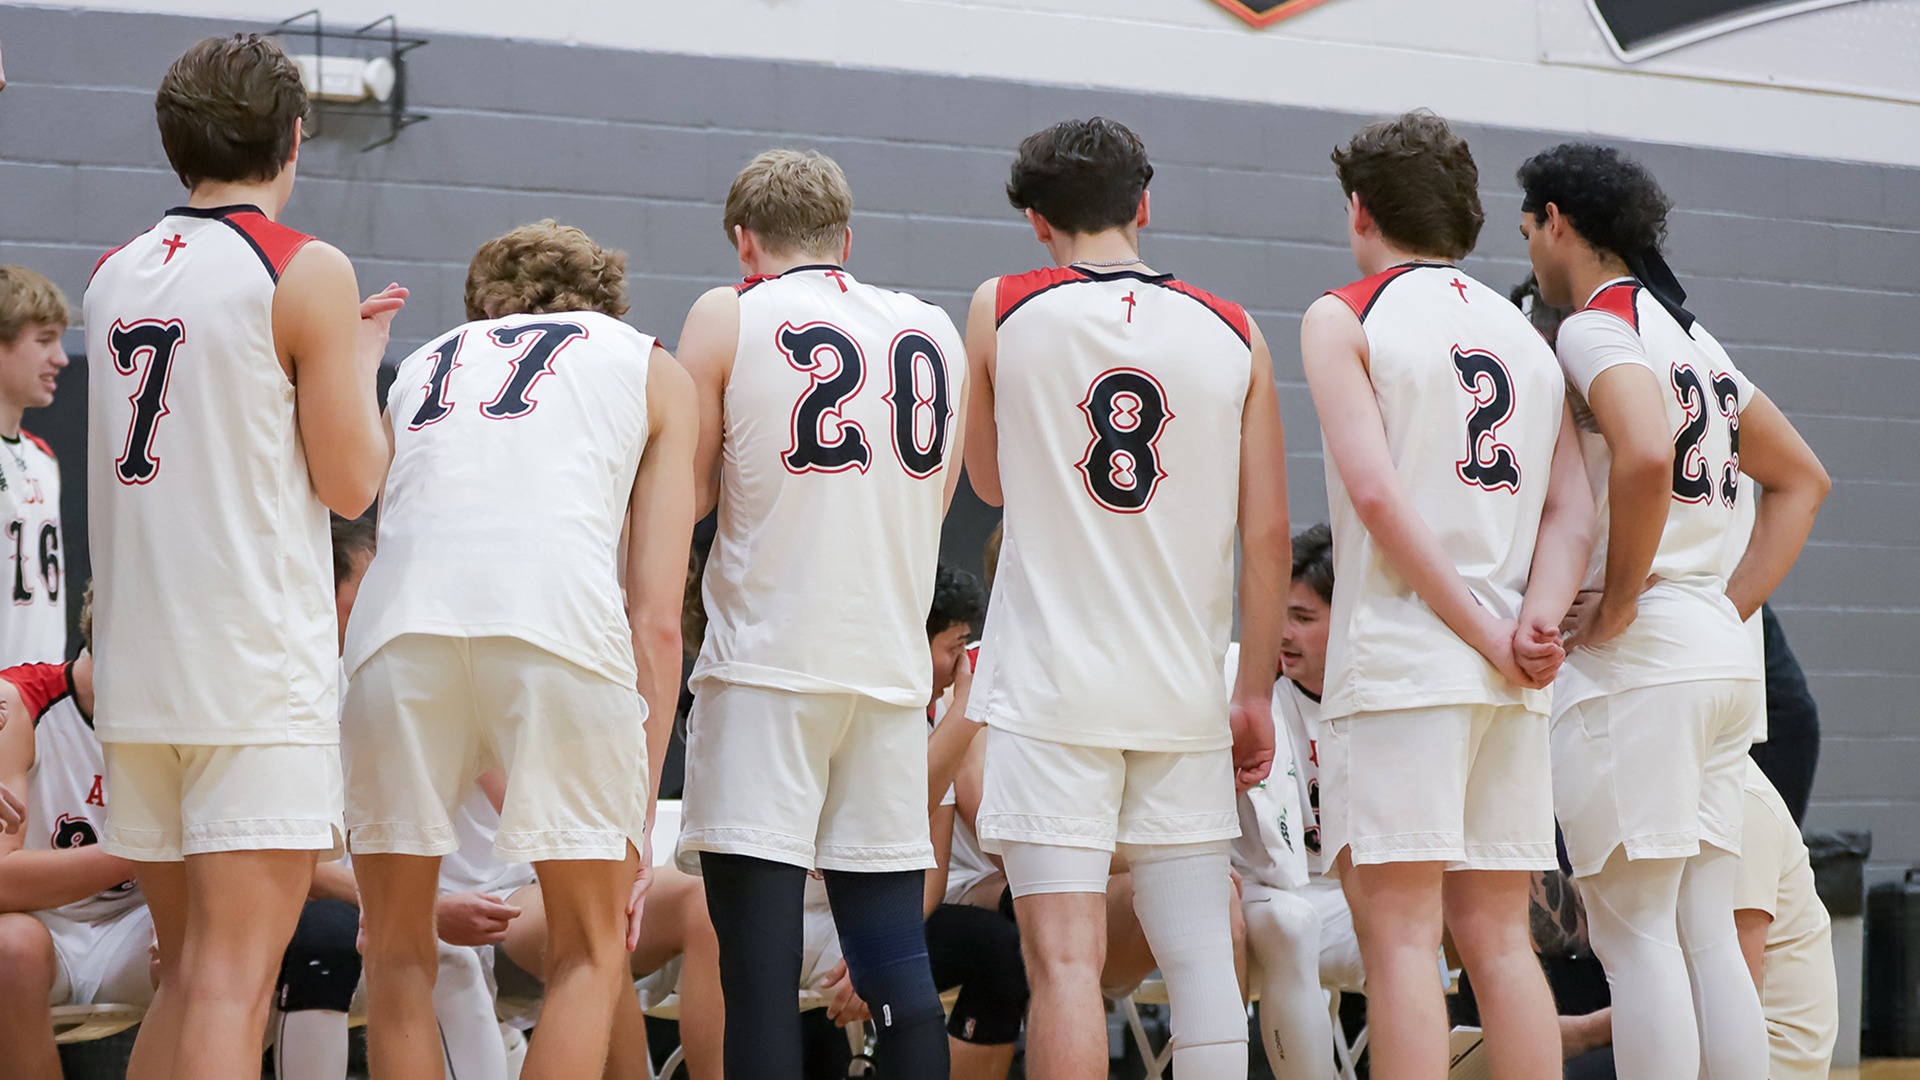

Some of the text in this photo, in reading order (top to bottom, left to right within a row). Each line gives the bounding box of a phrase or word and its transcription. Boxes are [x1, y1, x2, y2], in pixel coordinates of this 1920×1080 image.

[107, 317, 185, 486] 7
[407, 320, 589, 431] 17
[775, 320, 954, 480] 20
[1073, 366, 1176, 515] 8
[1450, 343, 1522, 495] 2
[5, 517, 64, 606] 16
[1273, 1029, 1286, 1061] NOCTA
